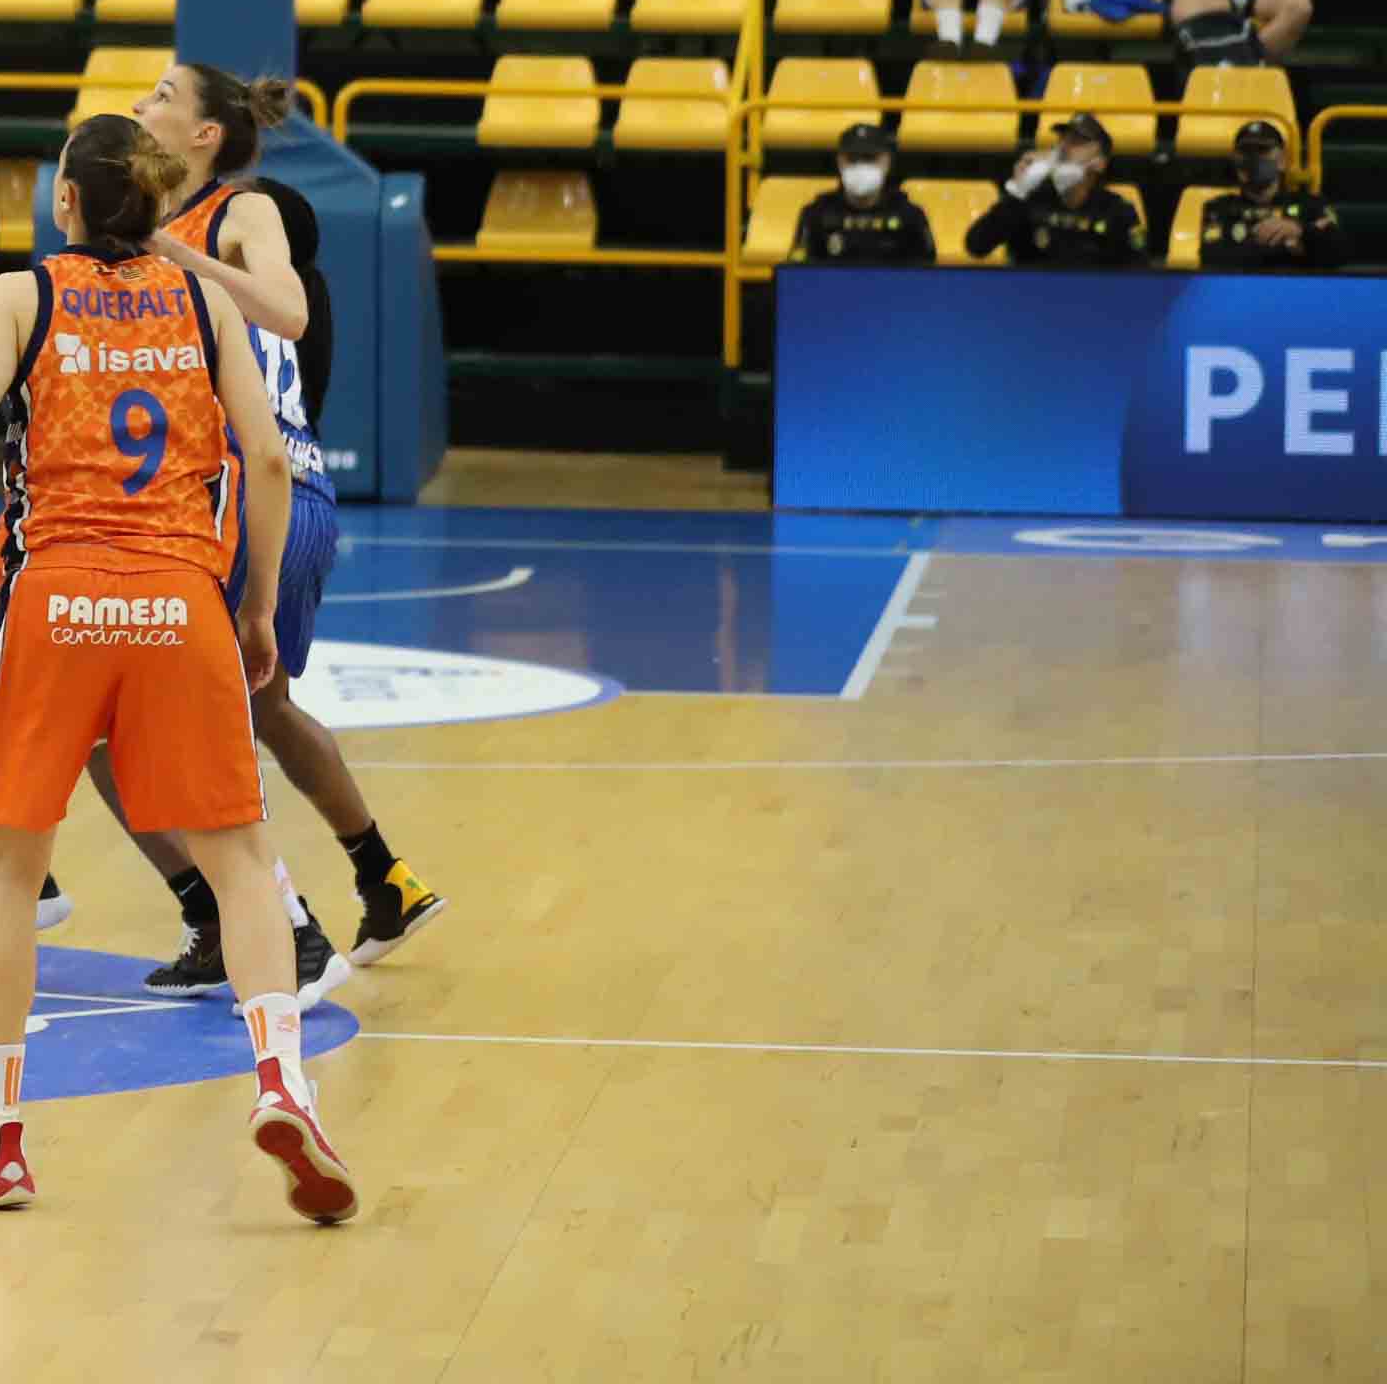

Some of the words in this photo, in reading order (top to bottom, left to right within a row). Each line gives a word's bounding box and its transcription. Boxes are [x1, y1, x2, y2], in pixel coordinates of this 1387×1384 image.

[62, 287, 187, 320] QUERALT
[109, 388, 169, 496] 9
[47, 594, 188, 626] PAMESA
